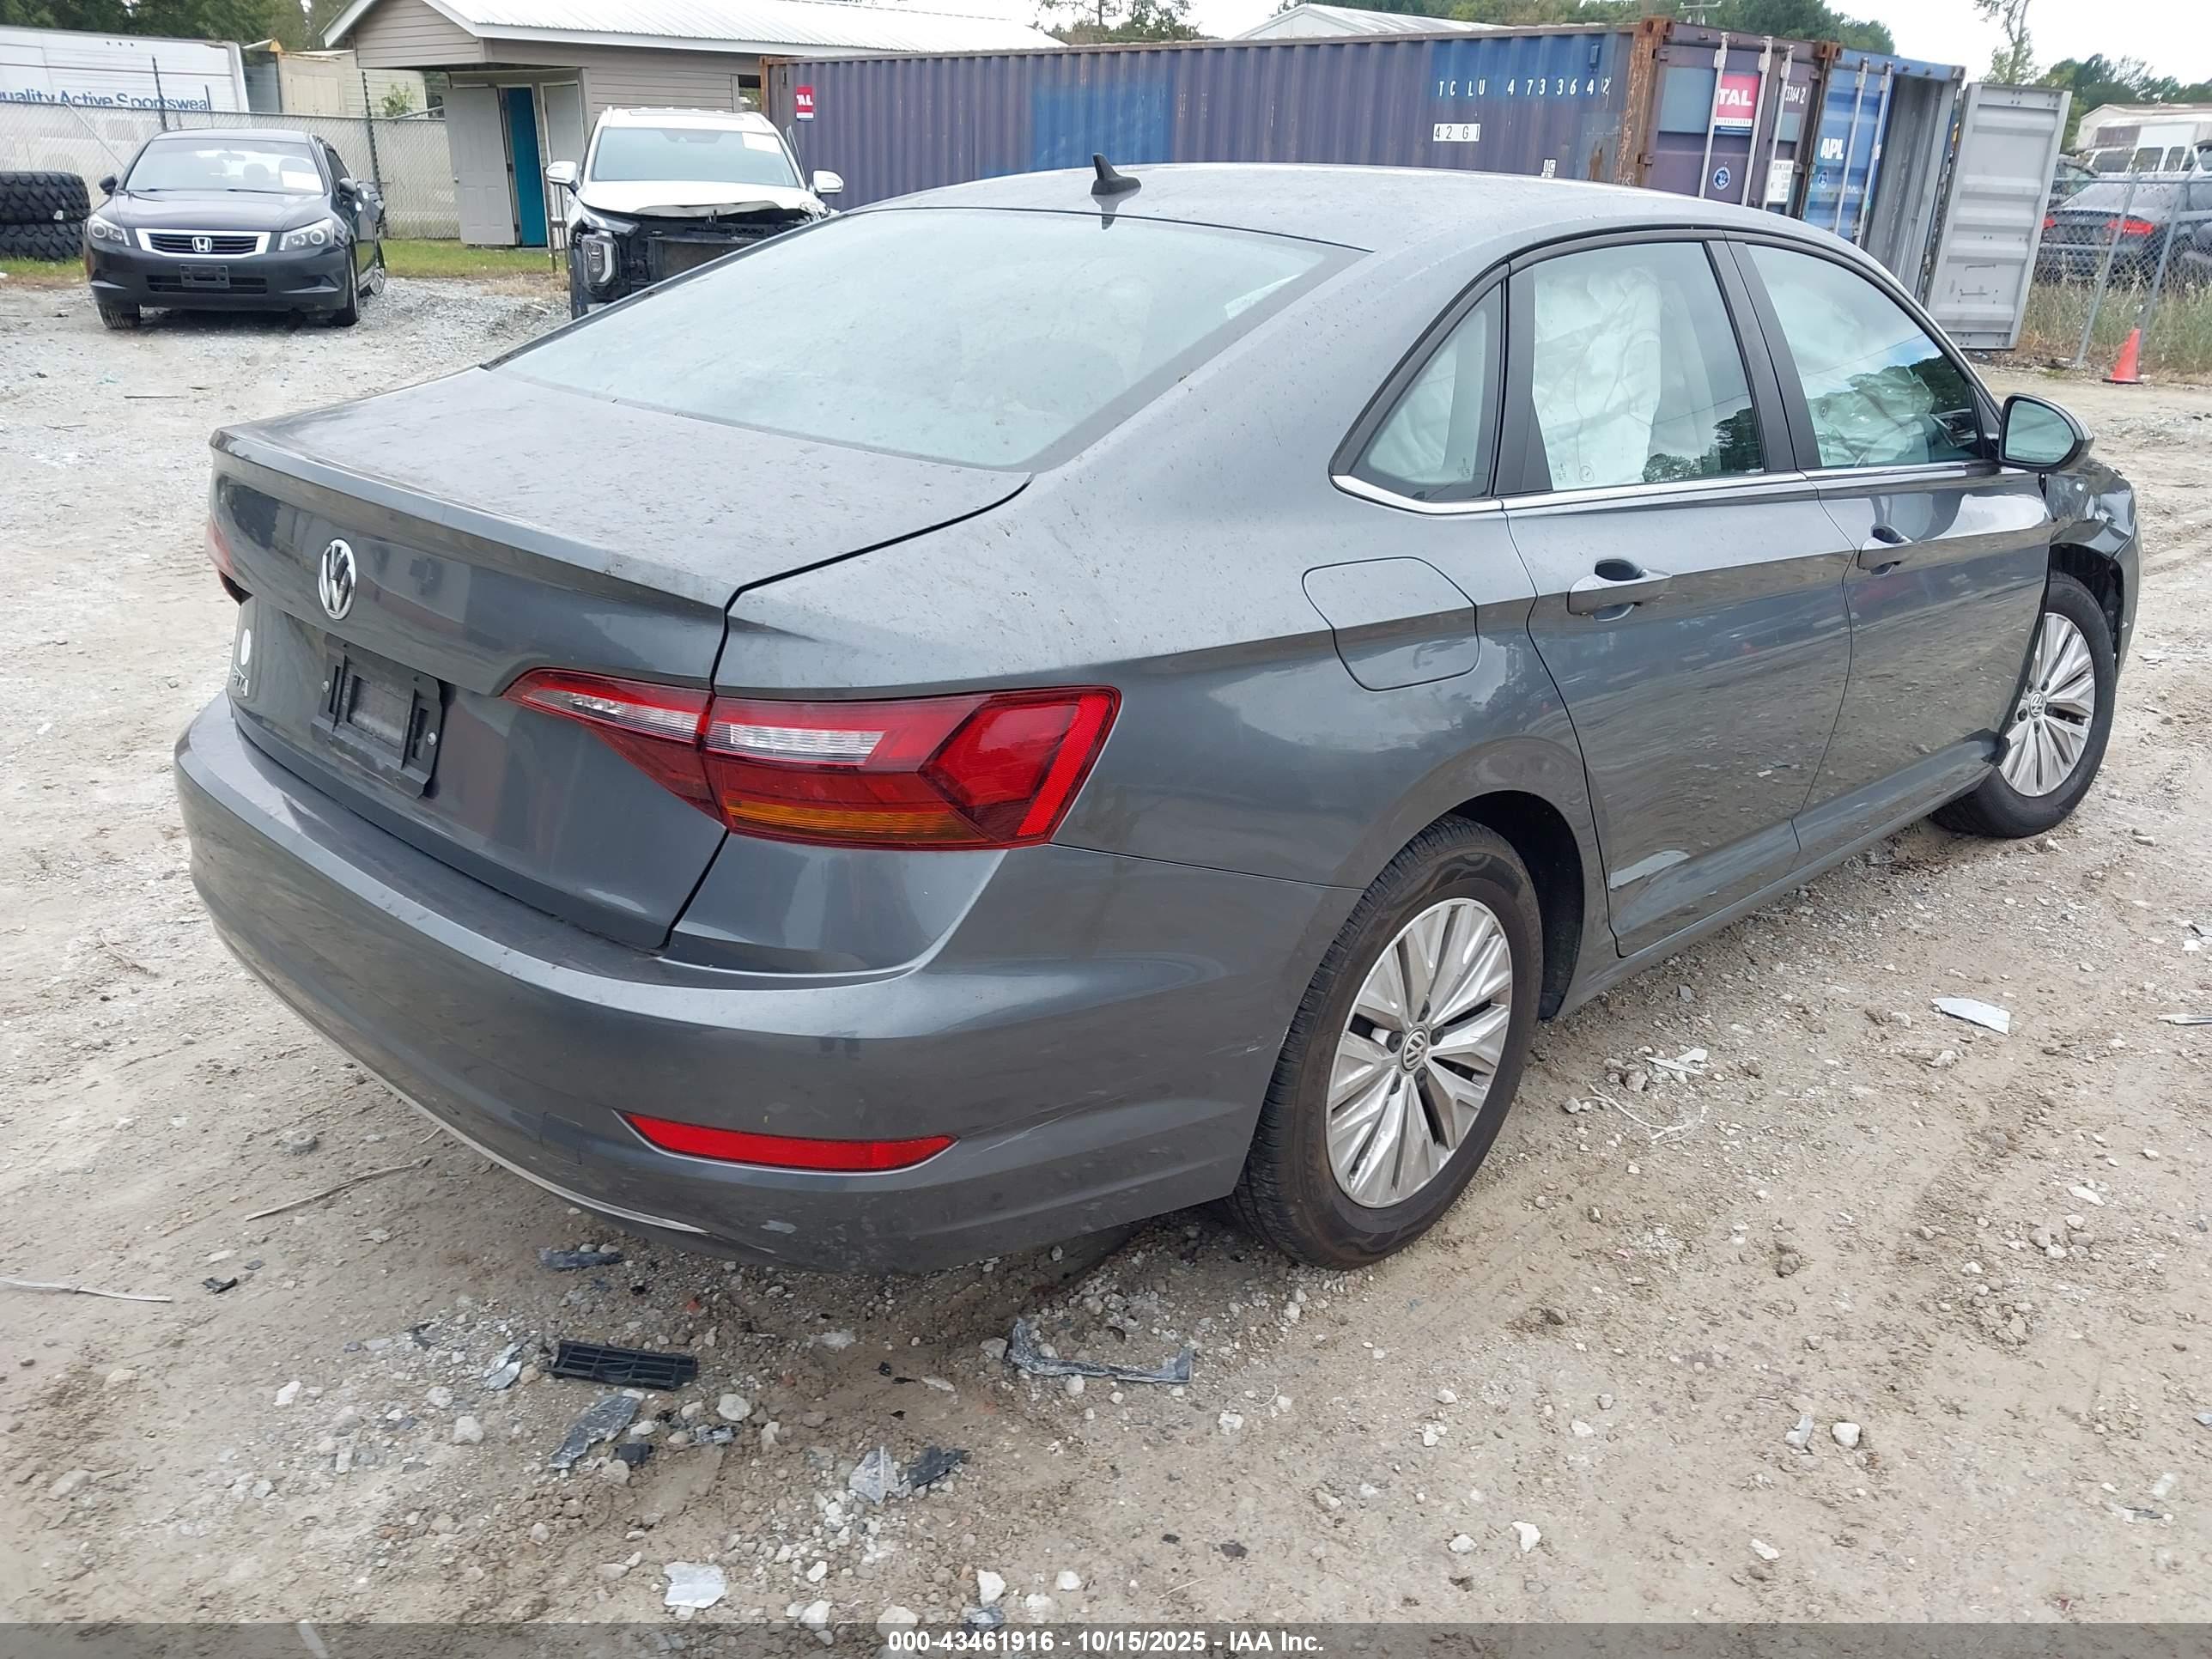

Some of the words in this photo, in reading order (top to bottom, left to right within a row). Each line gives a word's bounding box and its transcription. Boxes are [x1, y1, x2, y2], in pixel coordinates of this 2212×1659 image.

[0, 89, 55, 103] uality
[60, 89, 112, 106] Active
[1718, 88, 1753, 106] TAL
[1820, 138, 1844, 161] APL
